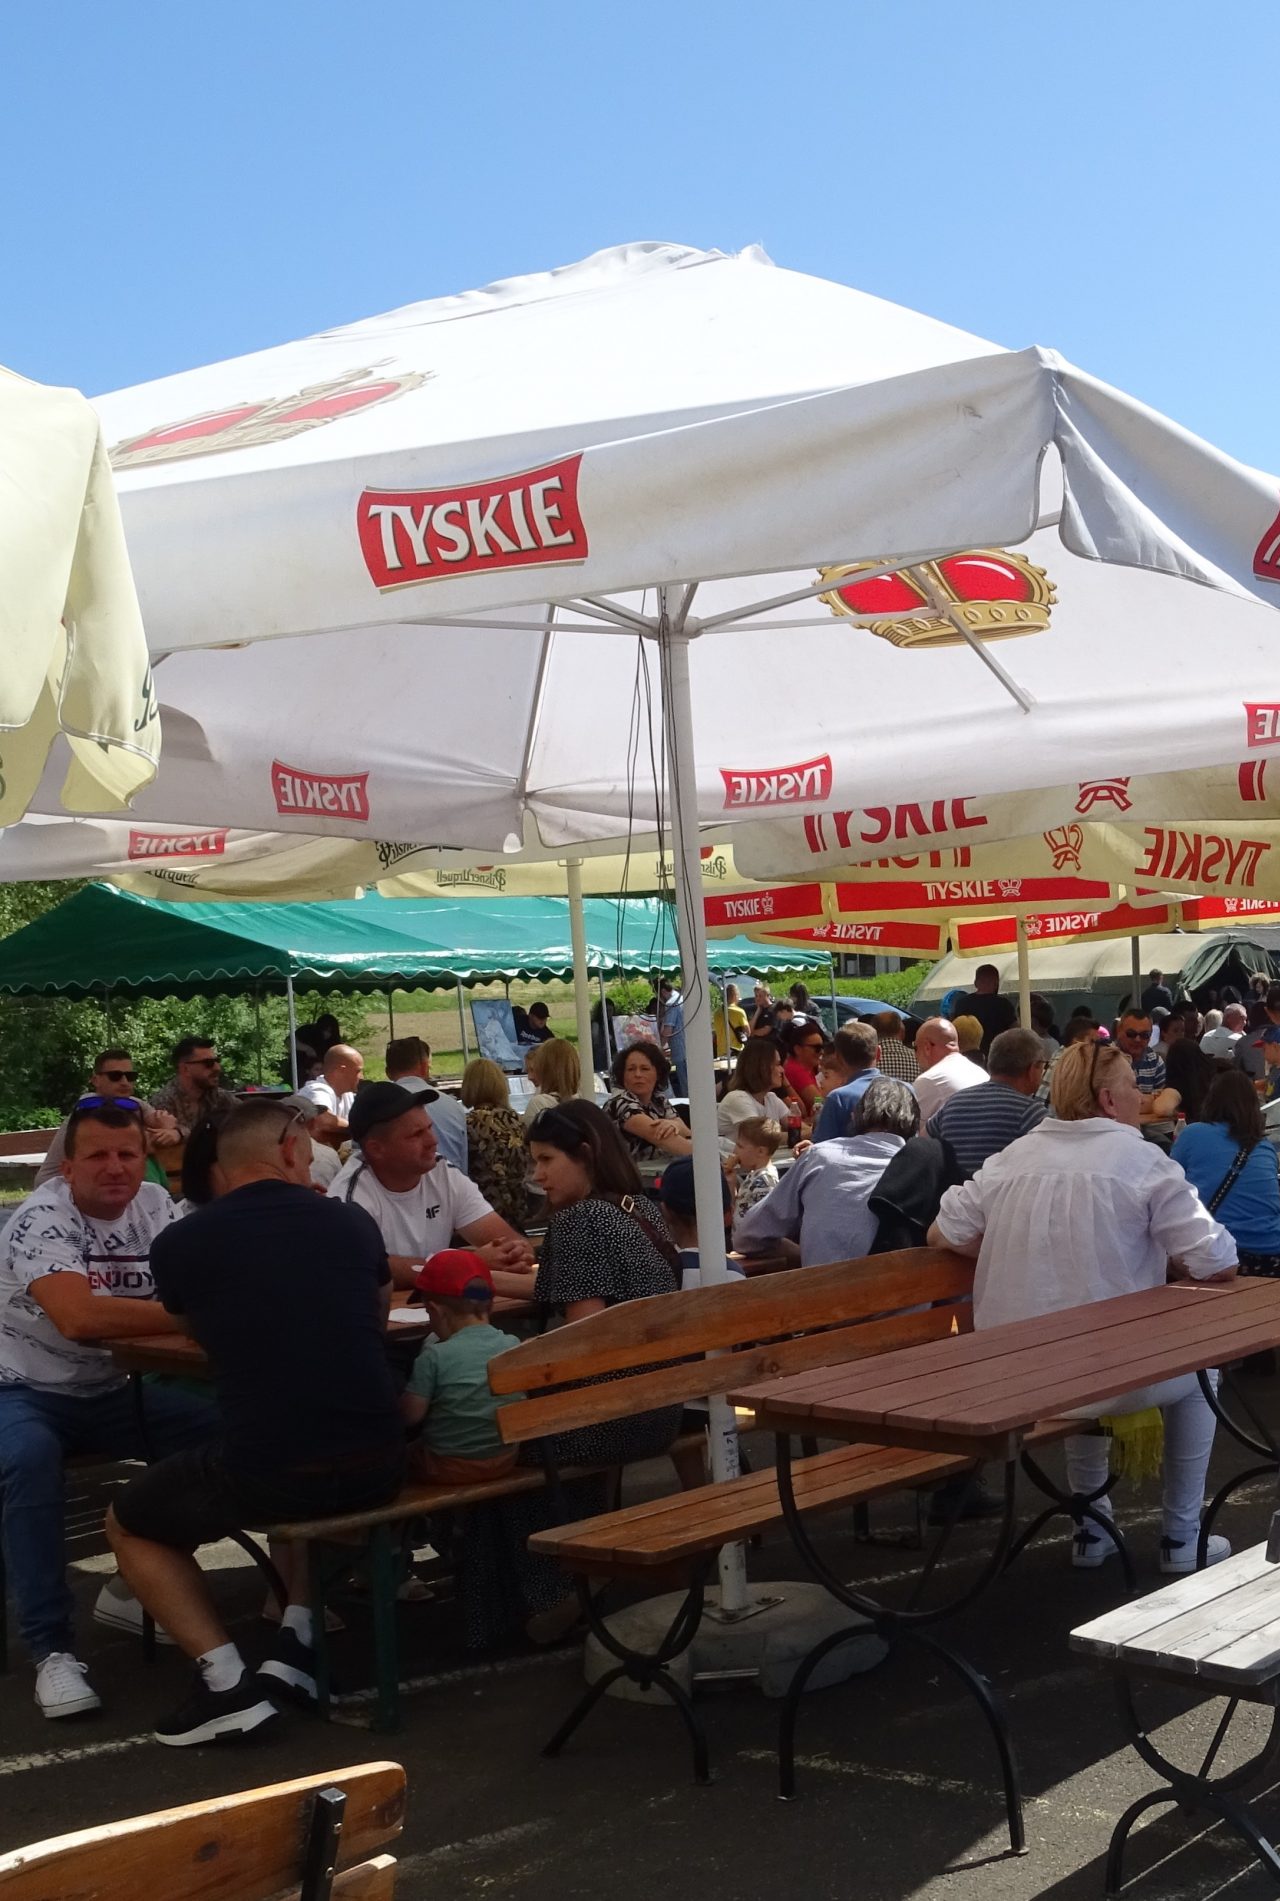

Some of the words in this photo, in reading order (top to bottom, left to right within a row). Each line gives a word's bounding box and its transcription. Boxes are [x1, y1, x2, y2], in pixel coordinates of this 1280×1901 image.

[368, 476, 575, 570] TYSKIE
[922, 880, 996, 900] TYSKIE
[724, 897, 761, 918] TYSKIE
